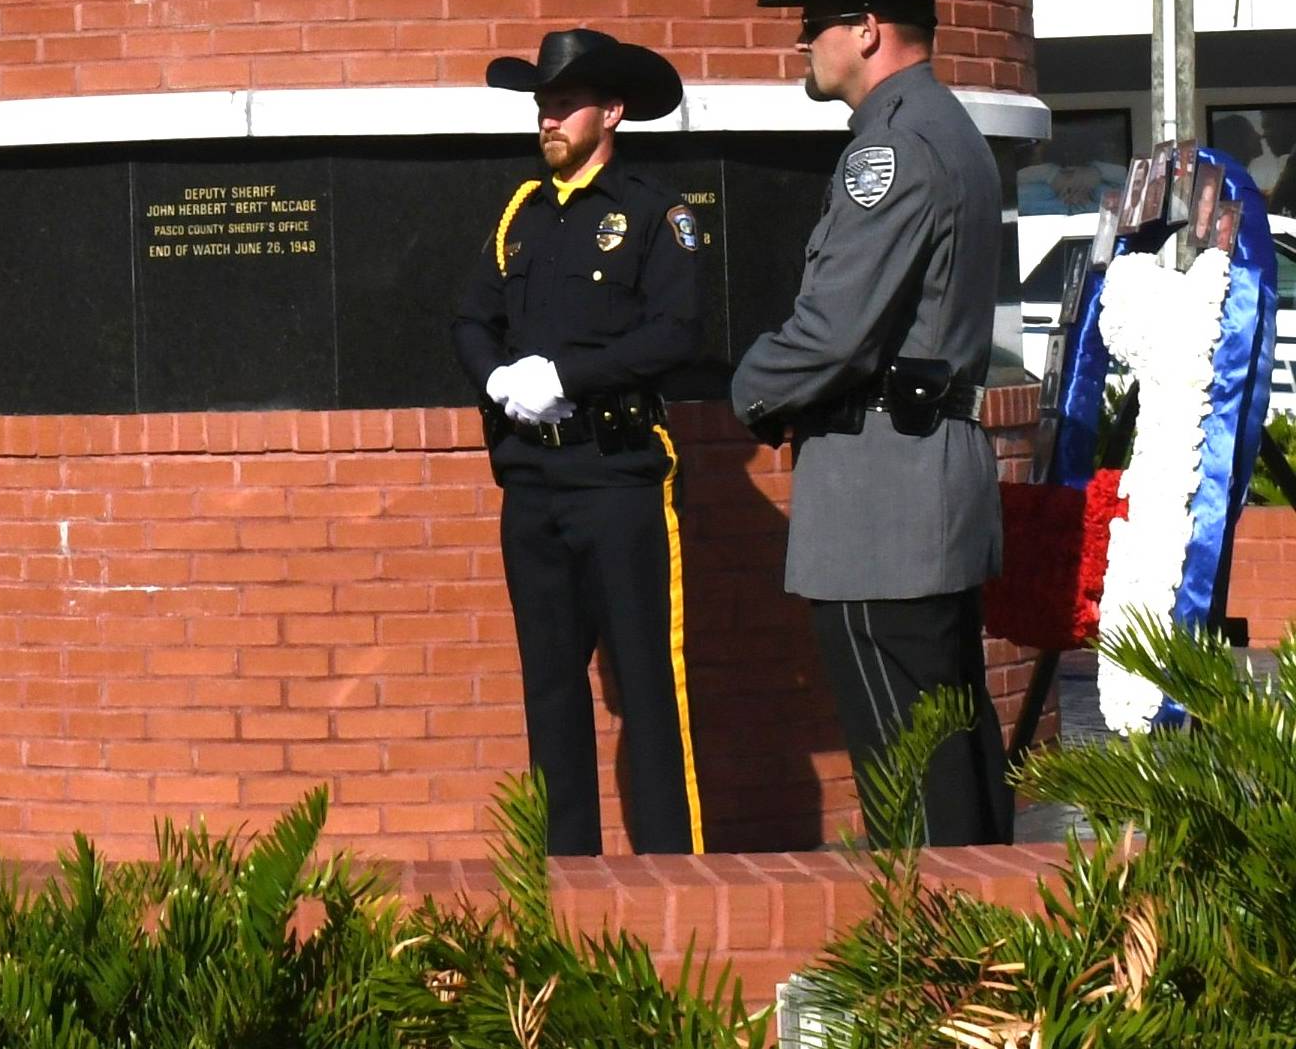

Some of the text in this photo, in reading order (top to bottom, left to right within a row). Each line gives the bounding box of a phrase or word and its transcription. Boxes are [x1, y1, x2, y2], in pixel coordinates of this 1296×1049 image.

[185, 185, 276, 200] DEPUTY SHERIFF
[147, 204, 175, 217] JOHN
[179, 203, 227, 216] HERBERT
[271, 200, 317, 212] MCCABE
[154, 221, 309, 236] PASCO COUNTY SHERIFF'S OFFICE
[149, 245, 171, 258] END
[175, 244, 189, 256] OF
[192, 243, 230, 255] WATCH
[234, 242, 261, 255] JUNE
[266, 241, 285, 255] 26,
